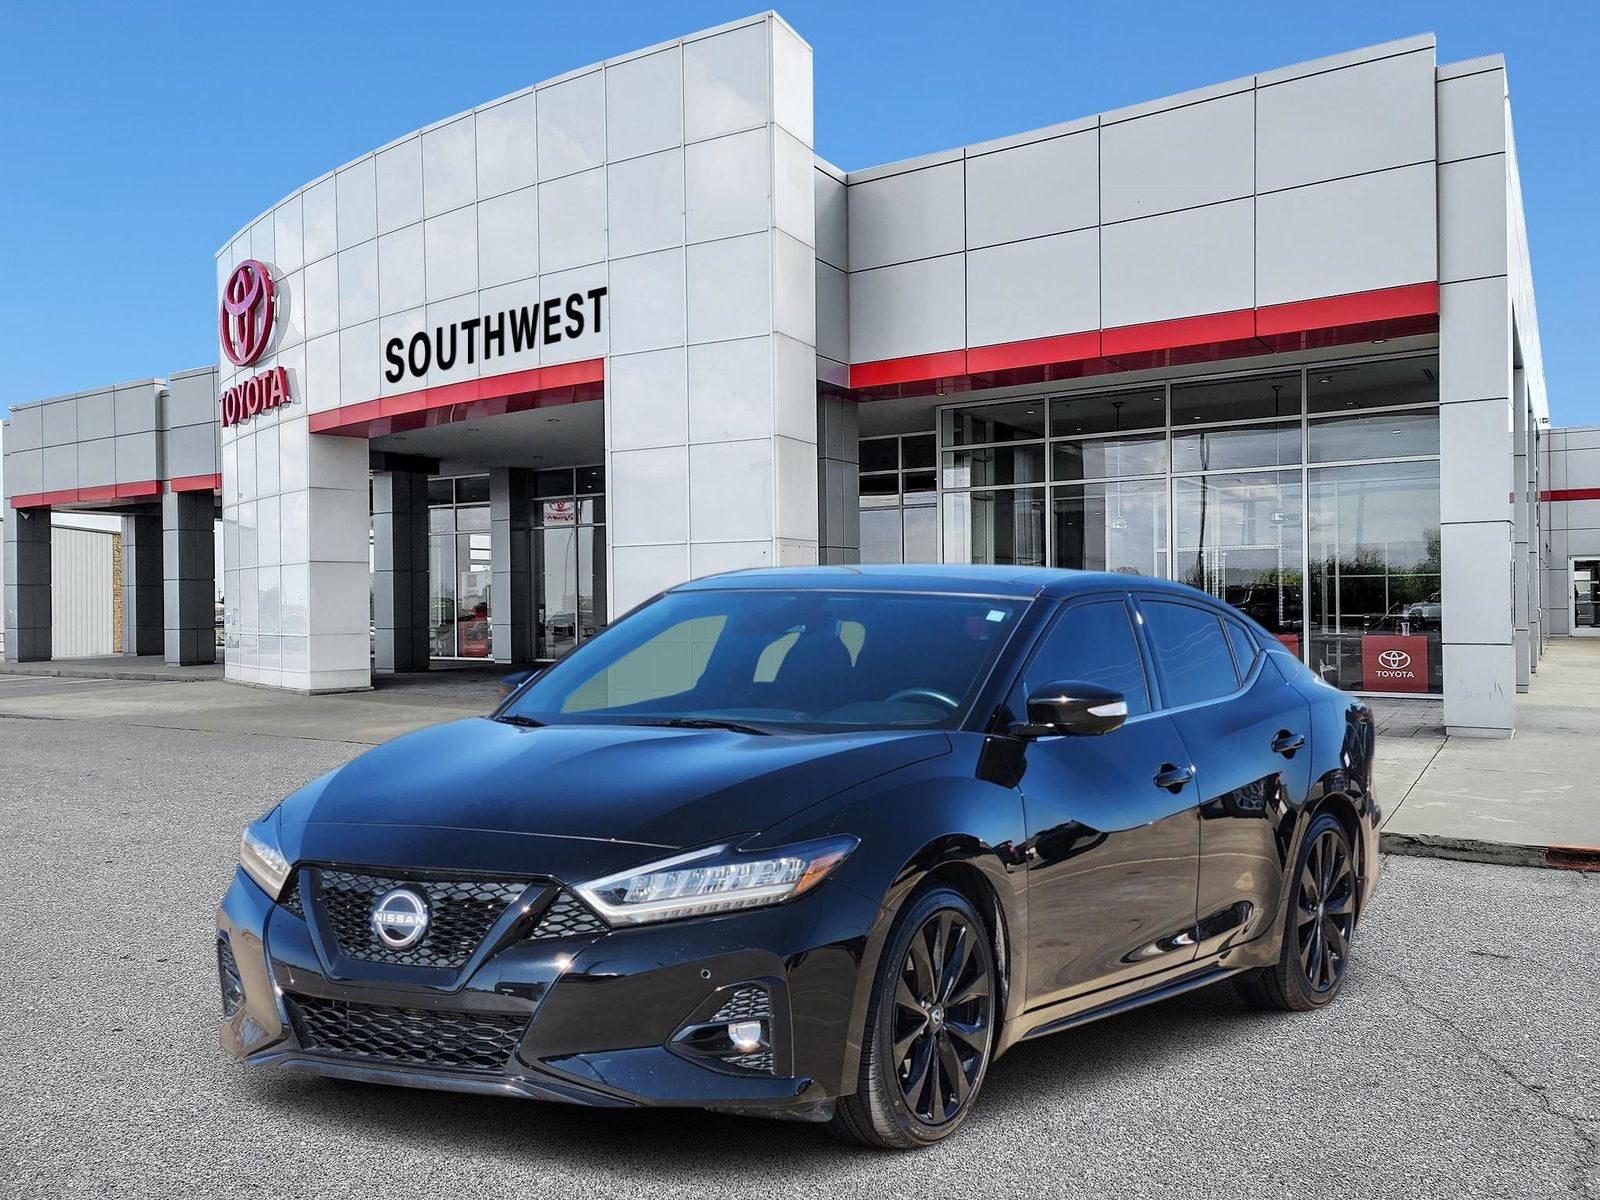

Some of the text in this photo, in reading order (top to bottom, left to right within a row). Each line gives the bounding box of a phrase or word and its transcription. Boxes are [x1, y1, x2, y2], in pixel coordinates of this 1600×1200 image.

[385, 287, 608, 383] SOUTHWEST
[219, 366, 290, 427] TOYOTA
[1376, 670, 1415, 678] TOYOTA
[374, 912, 426, 925] NISSAN
